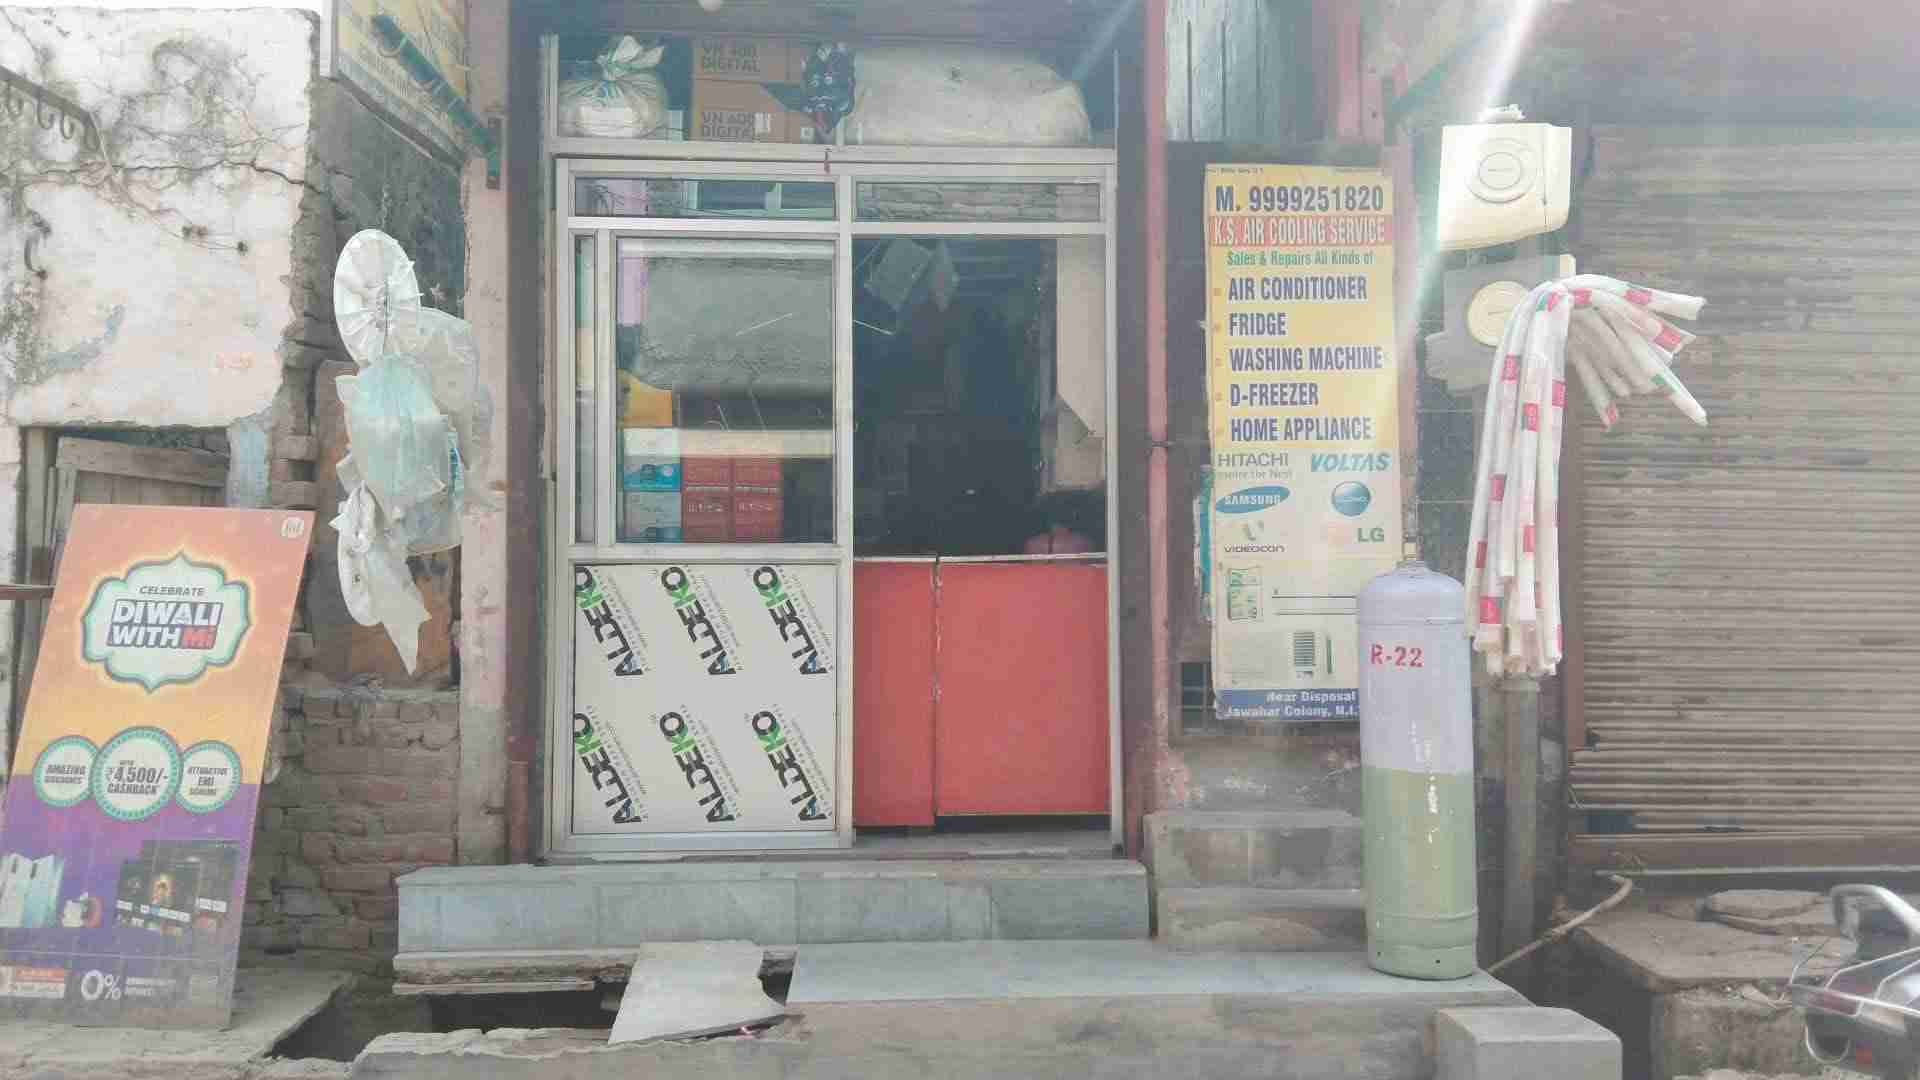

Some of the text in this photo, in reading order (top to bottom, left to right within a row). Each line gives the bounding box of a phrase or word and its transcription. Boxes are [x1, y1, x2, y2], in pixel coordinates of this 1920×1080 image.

[1215, 185, 1384, 212] M. 9999251820
[1243, 217, 1265, 245] AIR
[1269, 217, 1327, 245] COOLING
[1328, 216, 1385, 244] SERVICE
[1227, 251, 1255, 266] Sales
[1259, 251, 1268, 266] &
[1271, 251, 1311, 269] Repairs
[1314, 250, 1328, 266] All
[1331, 250, 1359, 265] Kinds
[1228, 275, 1367, 300] AIR CONDITIONER
[1229, 312, 1287, 336] FRIDGE
[1230, 346, 1382, 371] WASHING MACHINE
[1230, 382, 1319, 406] D-FREEZER
[1231, 417, 1372, 442] HOME APPLIANCE
[1217, 453, 1289, 467] HITACHI
[1311, 453, 1391, 473] VOLTAS
[1224, 494, 1281, 505] SAMSUNG
[1357, 527, 1384, 543] LG
[139, 585, 205, 597] CELEBRATE
[112, 599, 224, 625] DIWALI
[660, 566, 737, 676] ALDEKO
[752, 566, 829, 675] ALDEKO
[107, 624, 183, 649] WITH
[1370, 644, 1424, 668] R-22
[1300, 690, 1356, 704] Disposal
[1226, 705, 1281, 718] Jawahar
[1284, 705, 1331, 719] Colony,
[659, 711, 736, 823] ALDEKO
[752, 711, 828, 821] ALDEKO
[80, 969, 122, 1001] 0%
